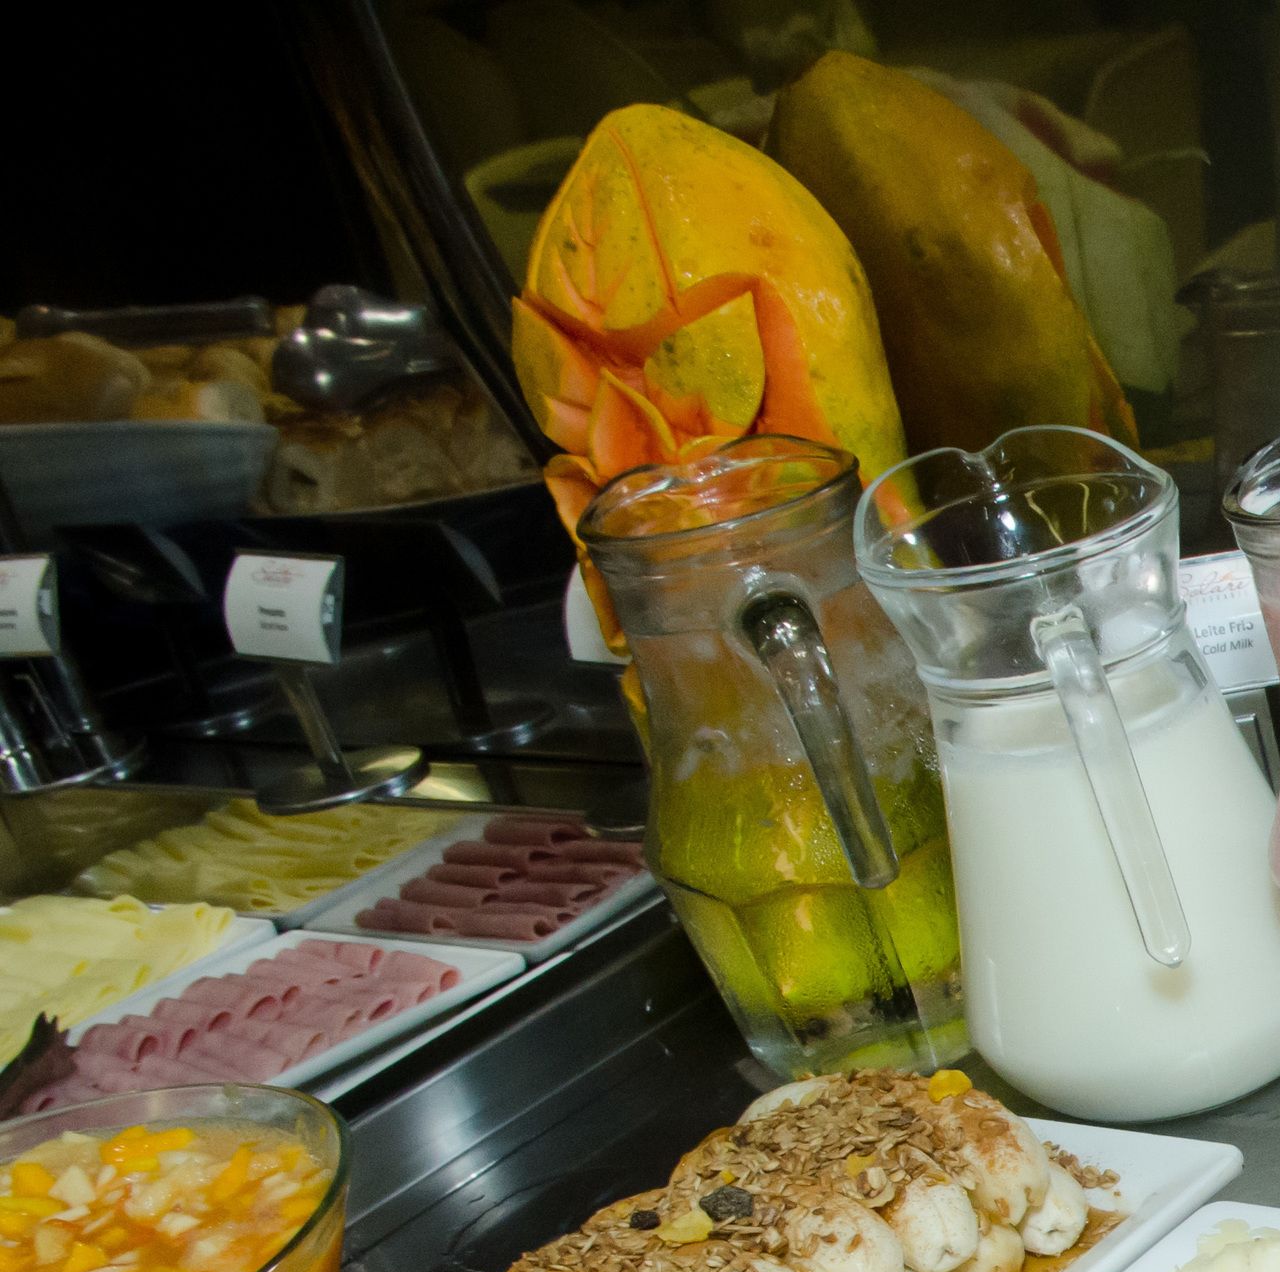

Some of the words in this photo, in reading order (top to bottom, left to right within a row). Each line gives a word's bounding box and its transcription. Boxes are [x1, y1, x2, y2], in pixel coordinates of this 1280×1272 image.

[1195, 625, 1225, 639] Leite
[1229, 620, 1254, 633] Frio
[1203, 643, 1227, 655] Cold
[1230, 638, 1253, 650] Milk
